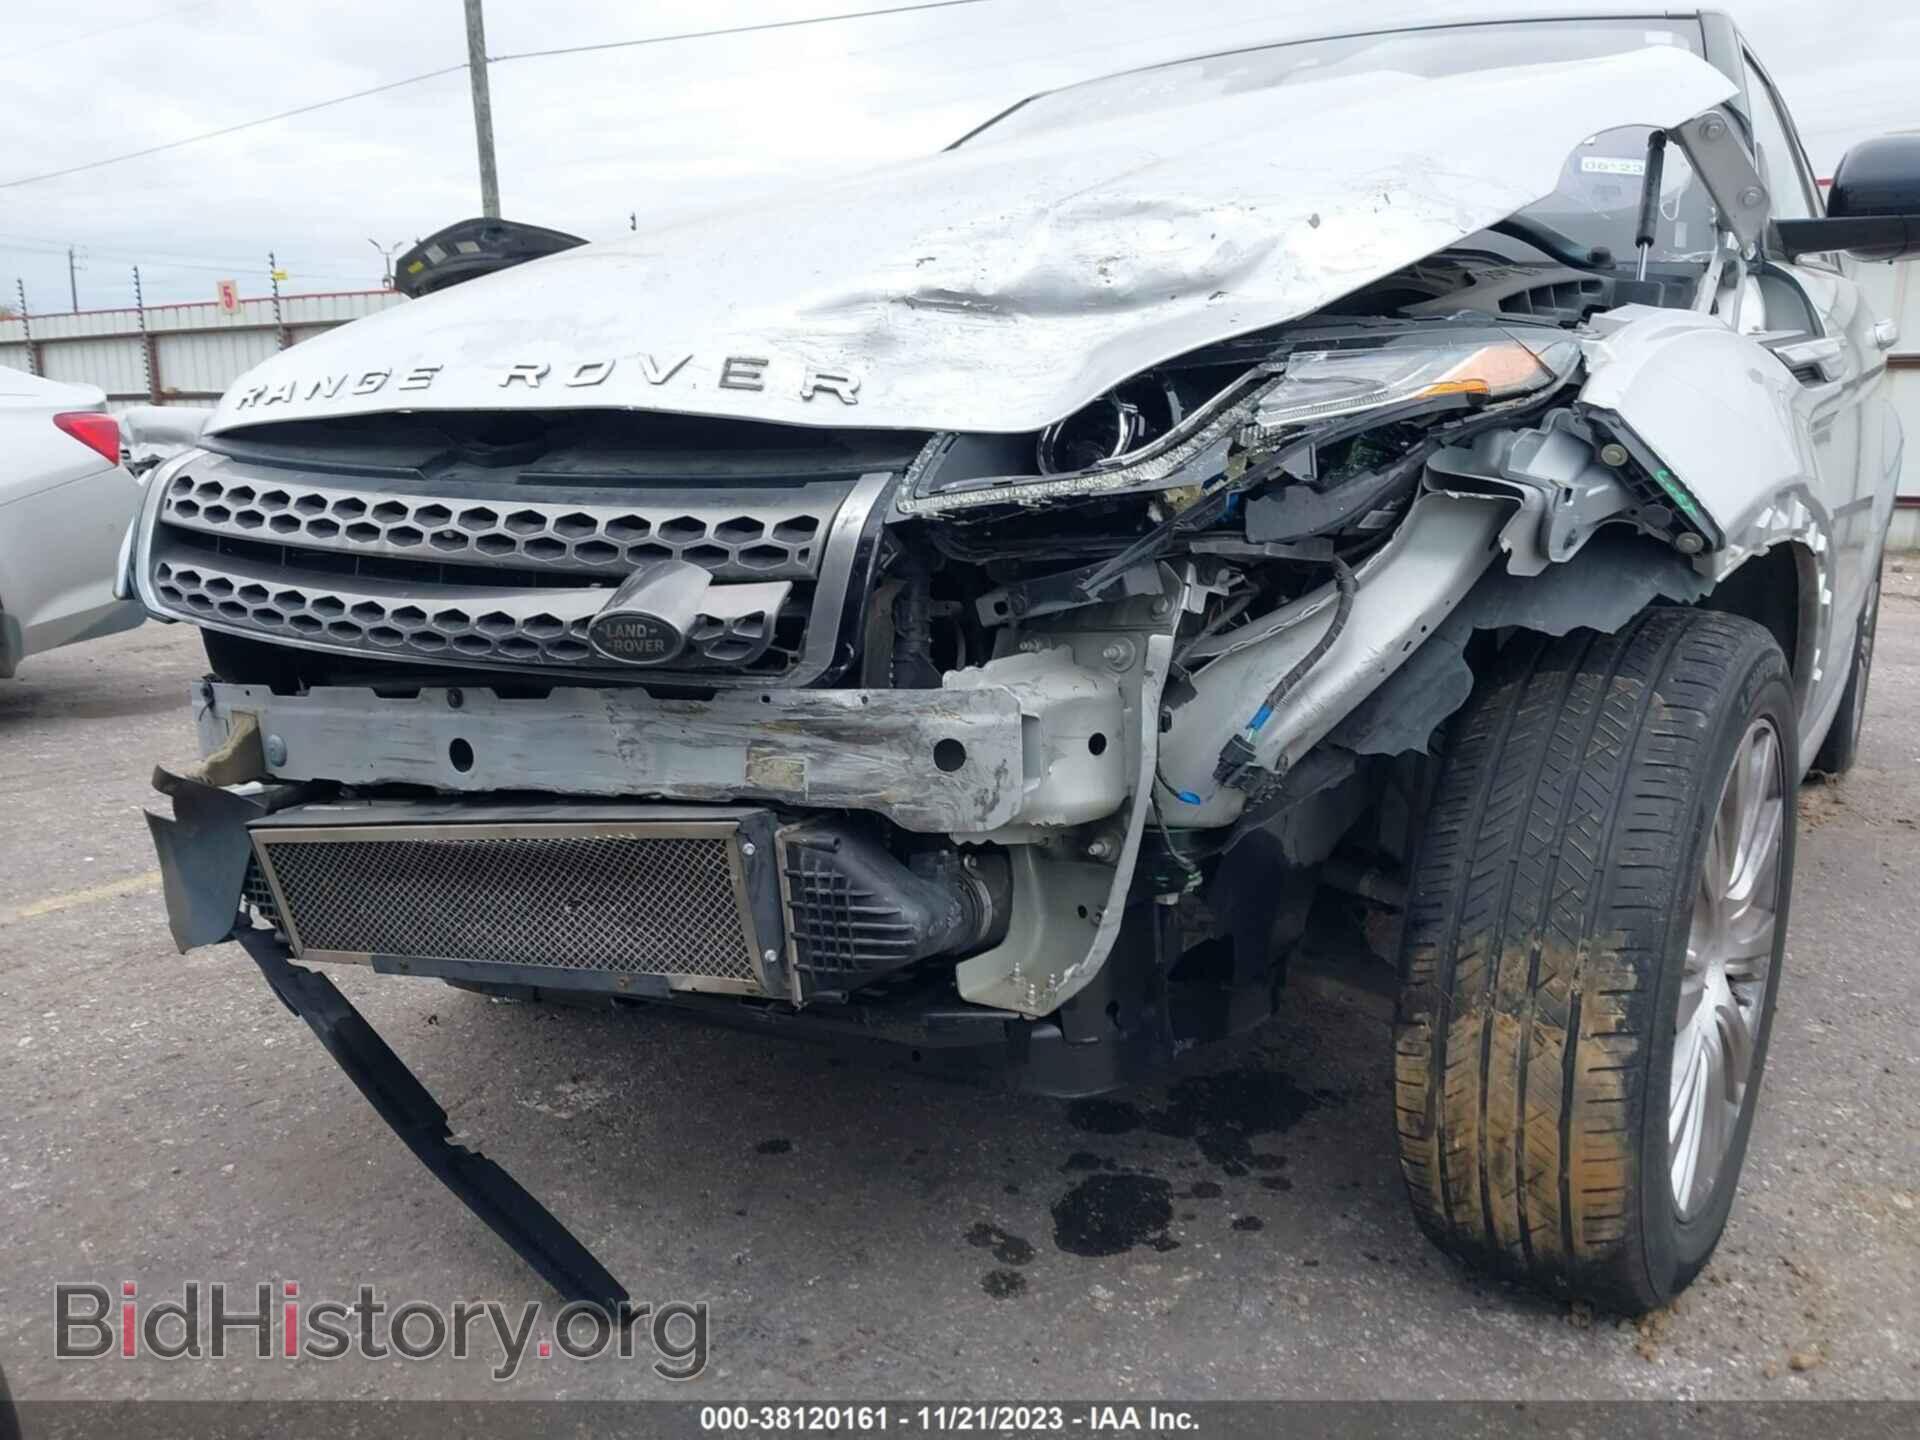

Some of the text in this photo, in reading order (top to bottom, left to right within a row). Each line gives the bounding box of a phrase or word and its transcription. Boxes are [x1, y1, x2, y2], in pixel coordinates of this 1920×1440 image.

[222, 285, 233, 309] 5
[236, 352, 863, 411] RANGE ROVER
[613, 638, 665, 653] ROVER
